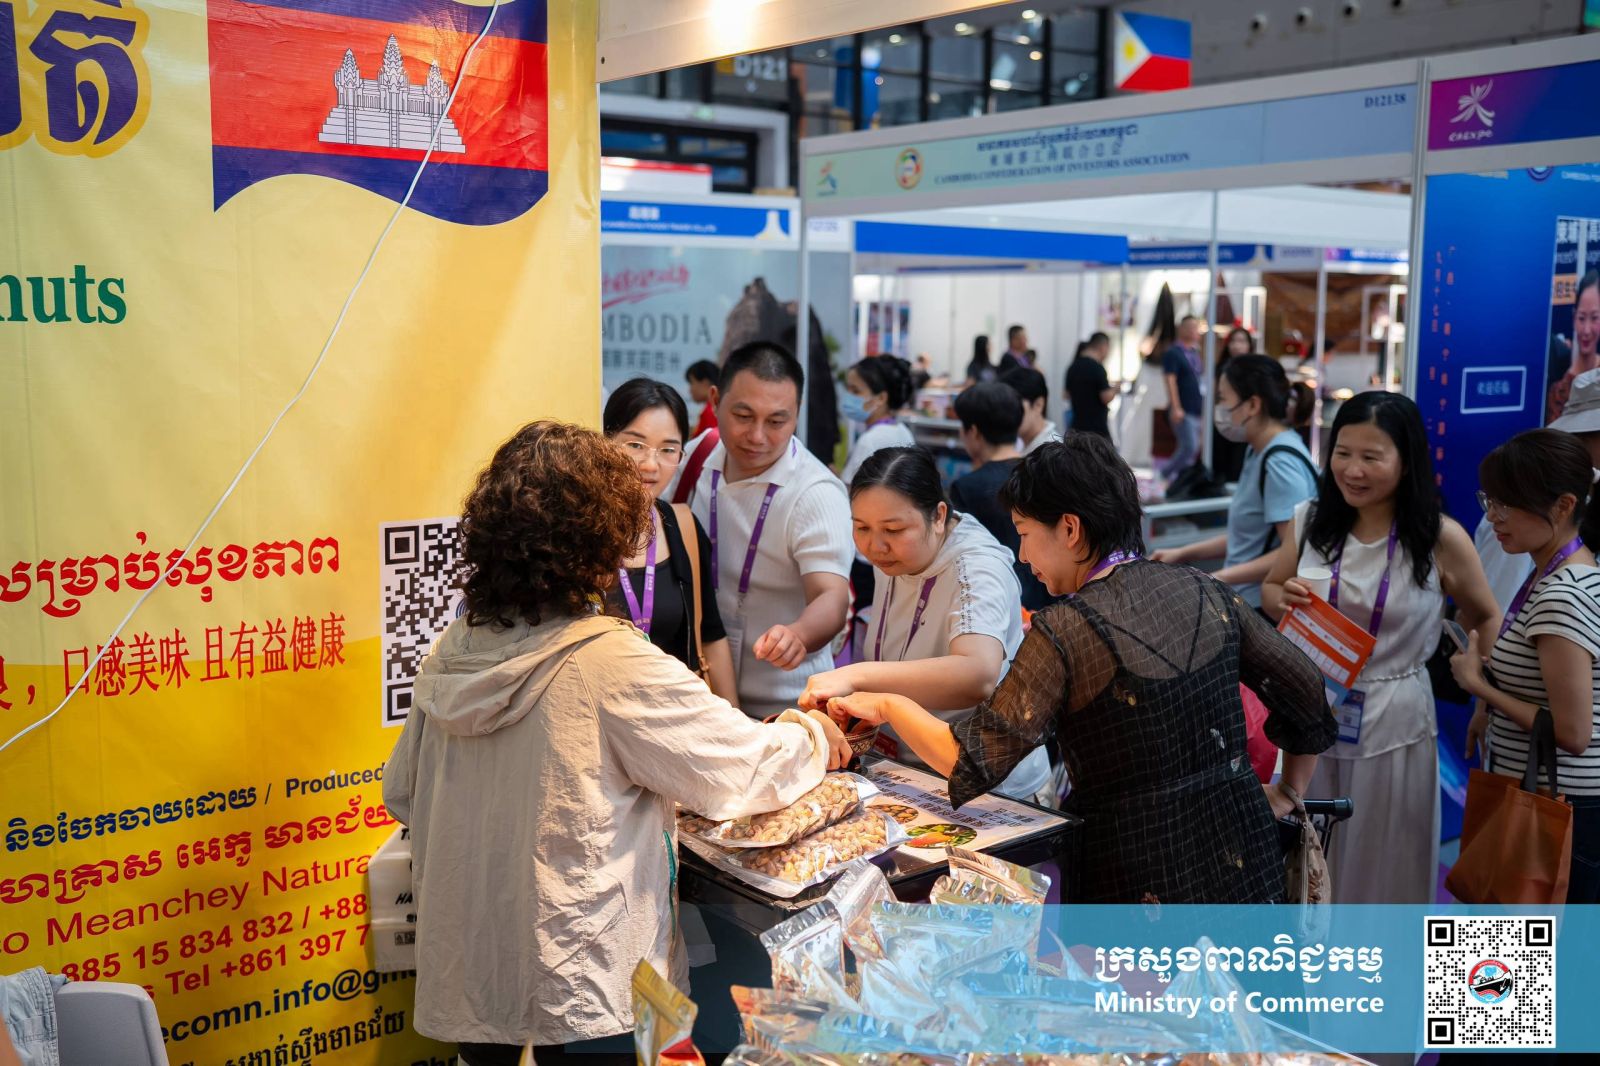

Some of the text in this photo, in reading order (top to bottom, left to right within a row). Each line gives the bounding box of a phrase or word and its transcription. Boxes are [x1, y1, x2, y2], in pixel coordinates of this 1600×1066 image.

[286, 763, 386, 798] Produced
[47, 882, 249, 946] Meanchey
[263, 846, 379, 896] Natura
[133, 941, 169, 970] 15
[179, 925, 233, 959] 834
[242, 911, 293, 943] 832
[319, 893, 370, 920] +88
[165, 965, 209, 995] Tel
[220, 944, 286, 977] +861
[300, 930, 347, 961] 397
